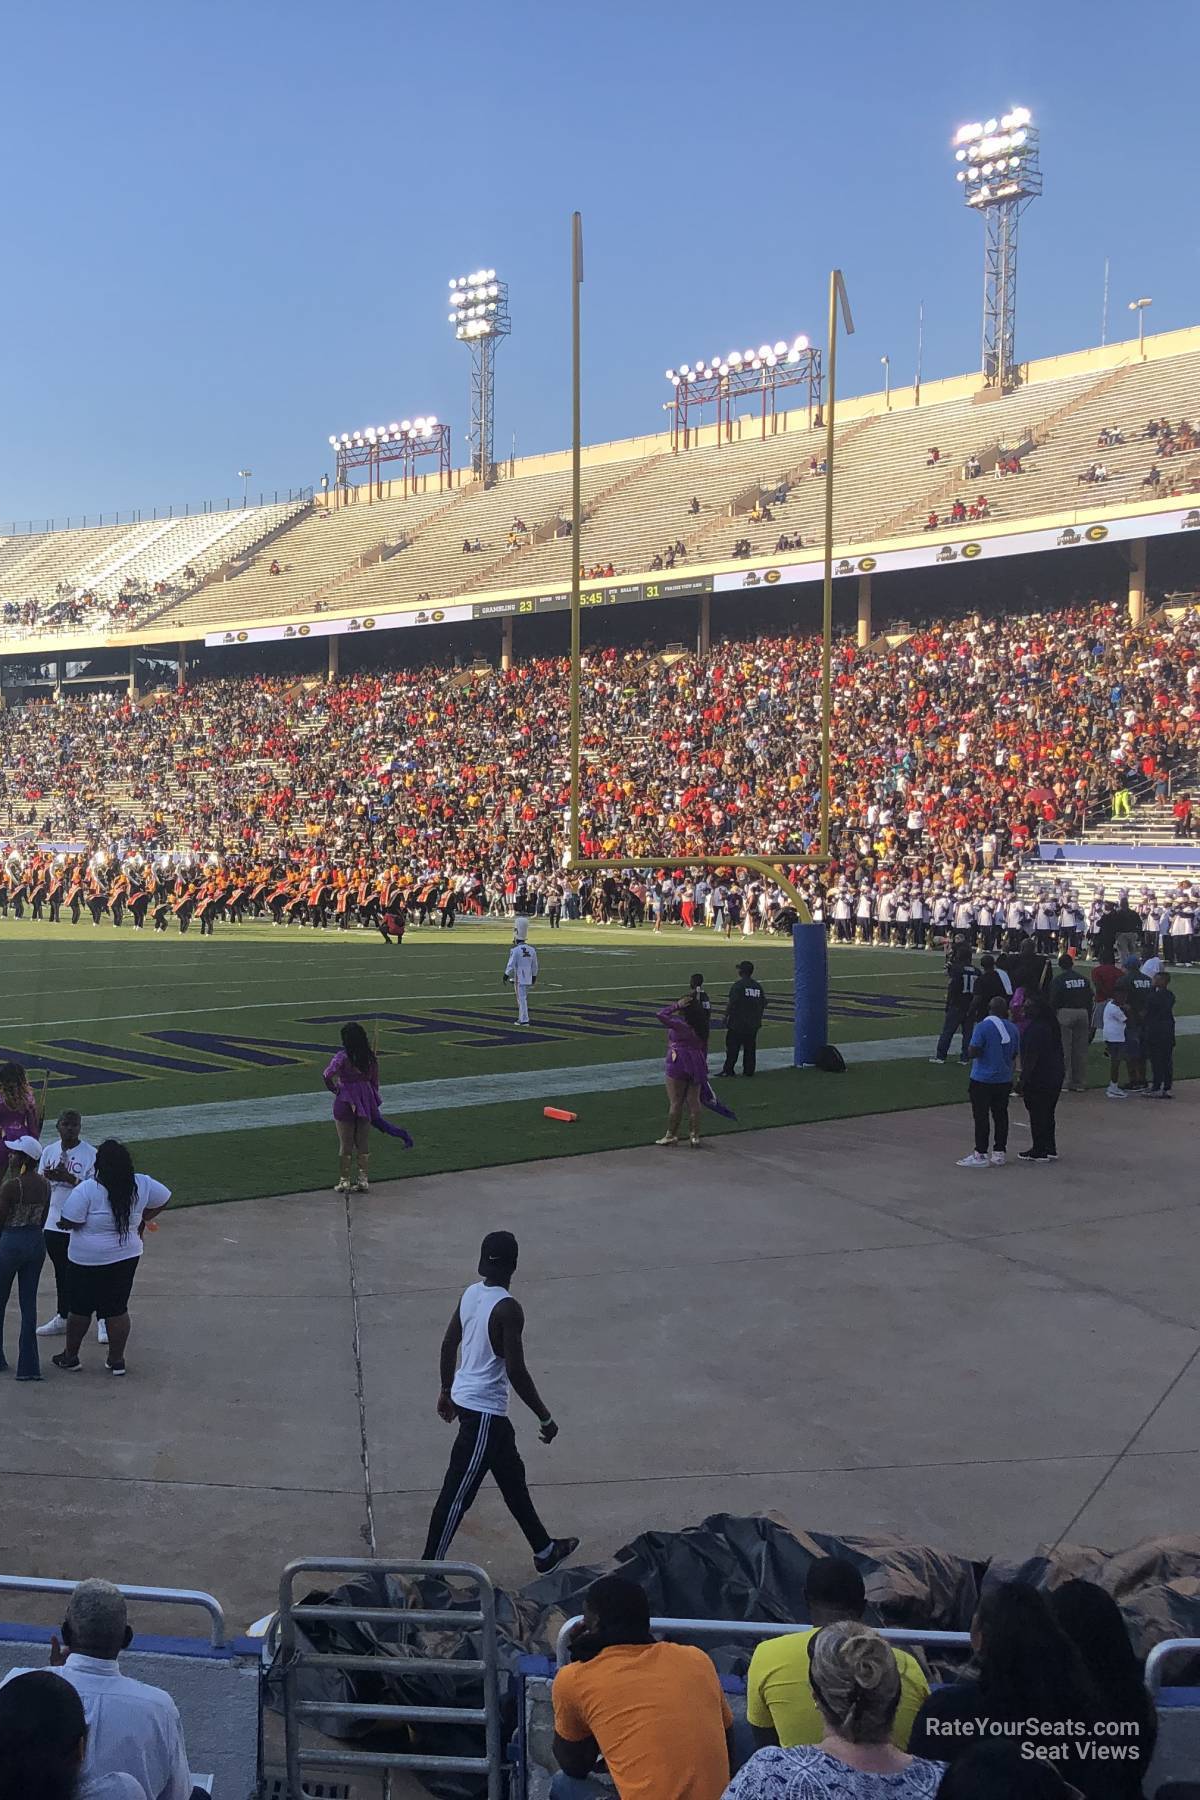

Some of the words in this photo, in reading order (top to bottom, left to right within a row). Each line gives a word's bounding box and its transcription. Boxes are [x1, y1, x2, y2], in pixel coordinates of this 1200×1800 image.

[647, 586, 659, 598] 31
[482, 604, 516, 614] GRAMBLING
[519, 601, 533, 612] 23
[1065, 979, 1085, 988] STAFF
[745, 988, 760, 998] STAFF
